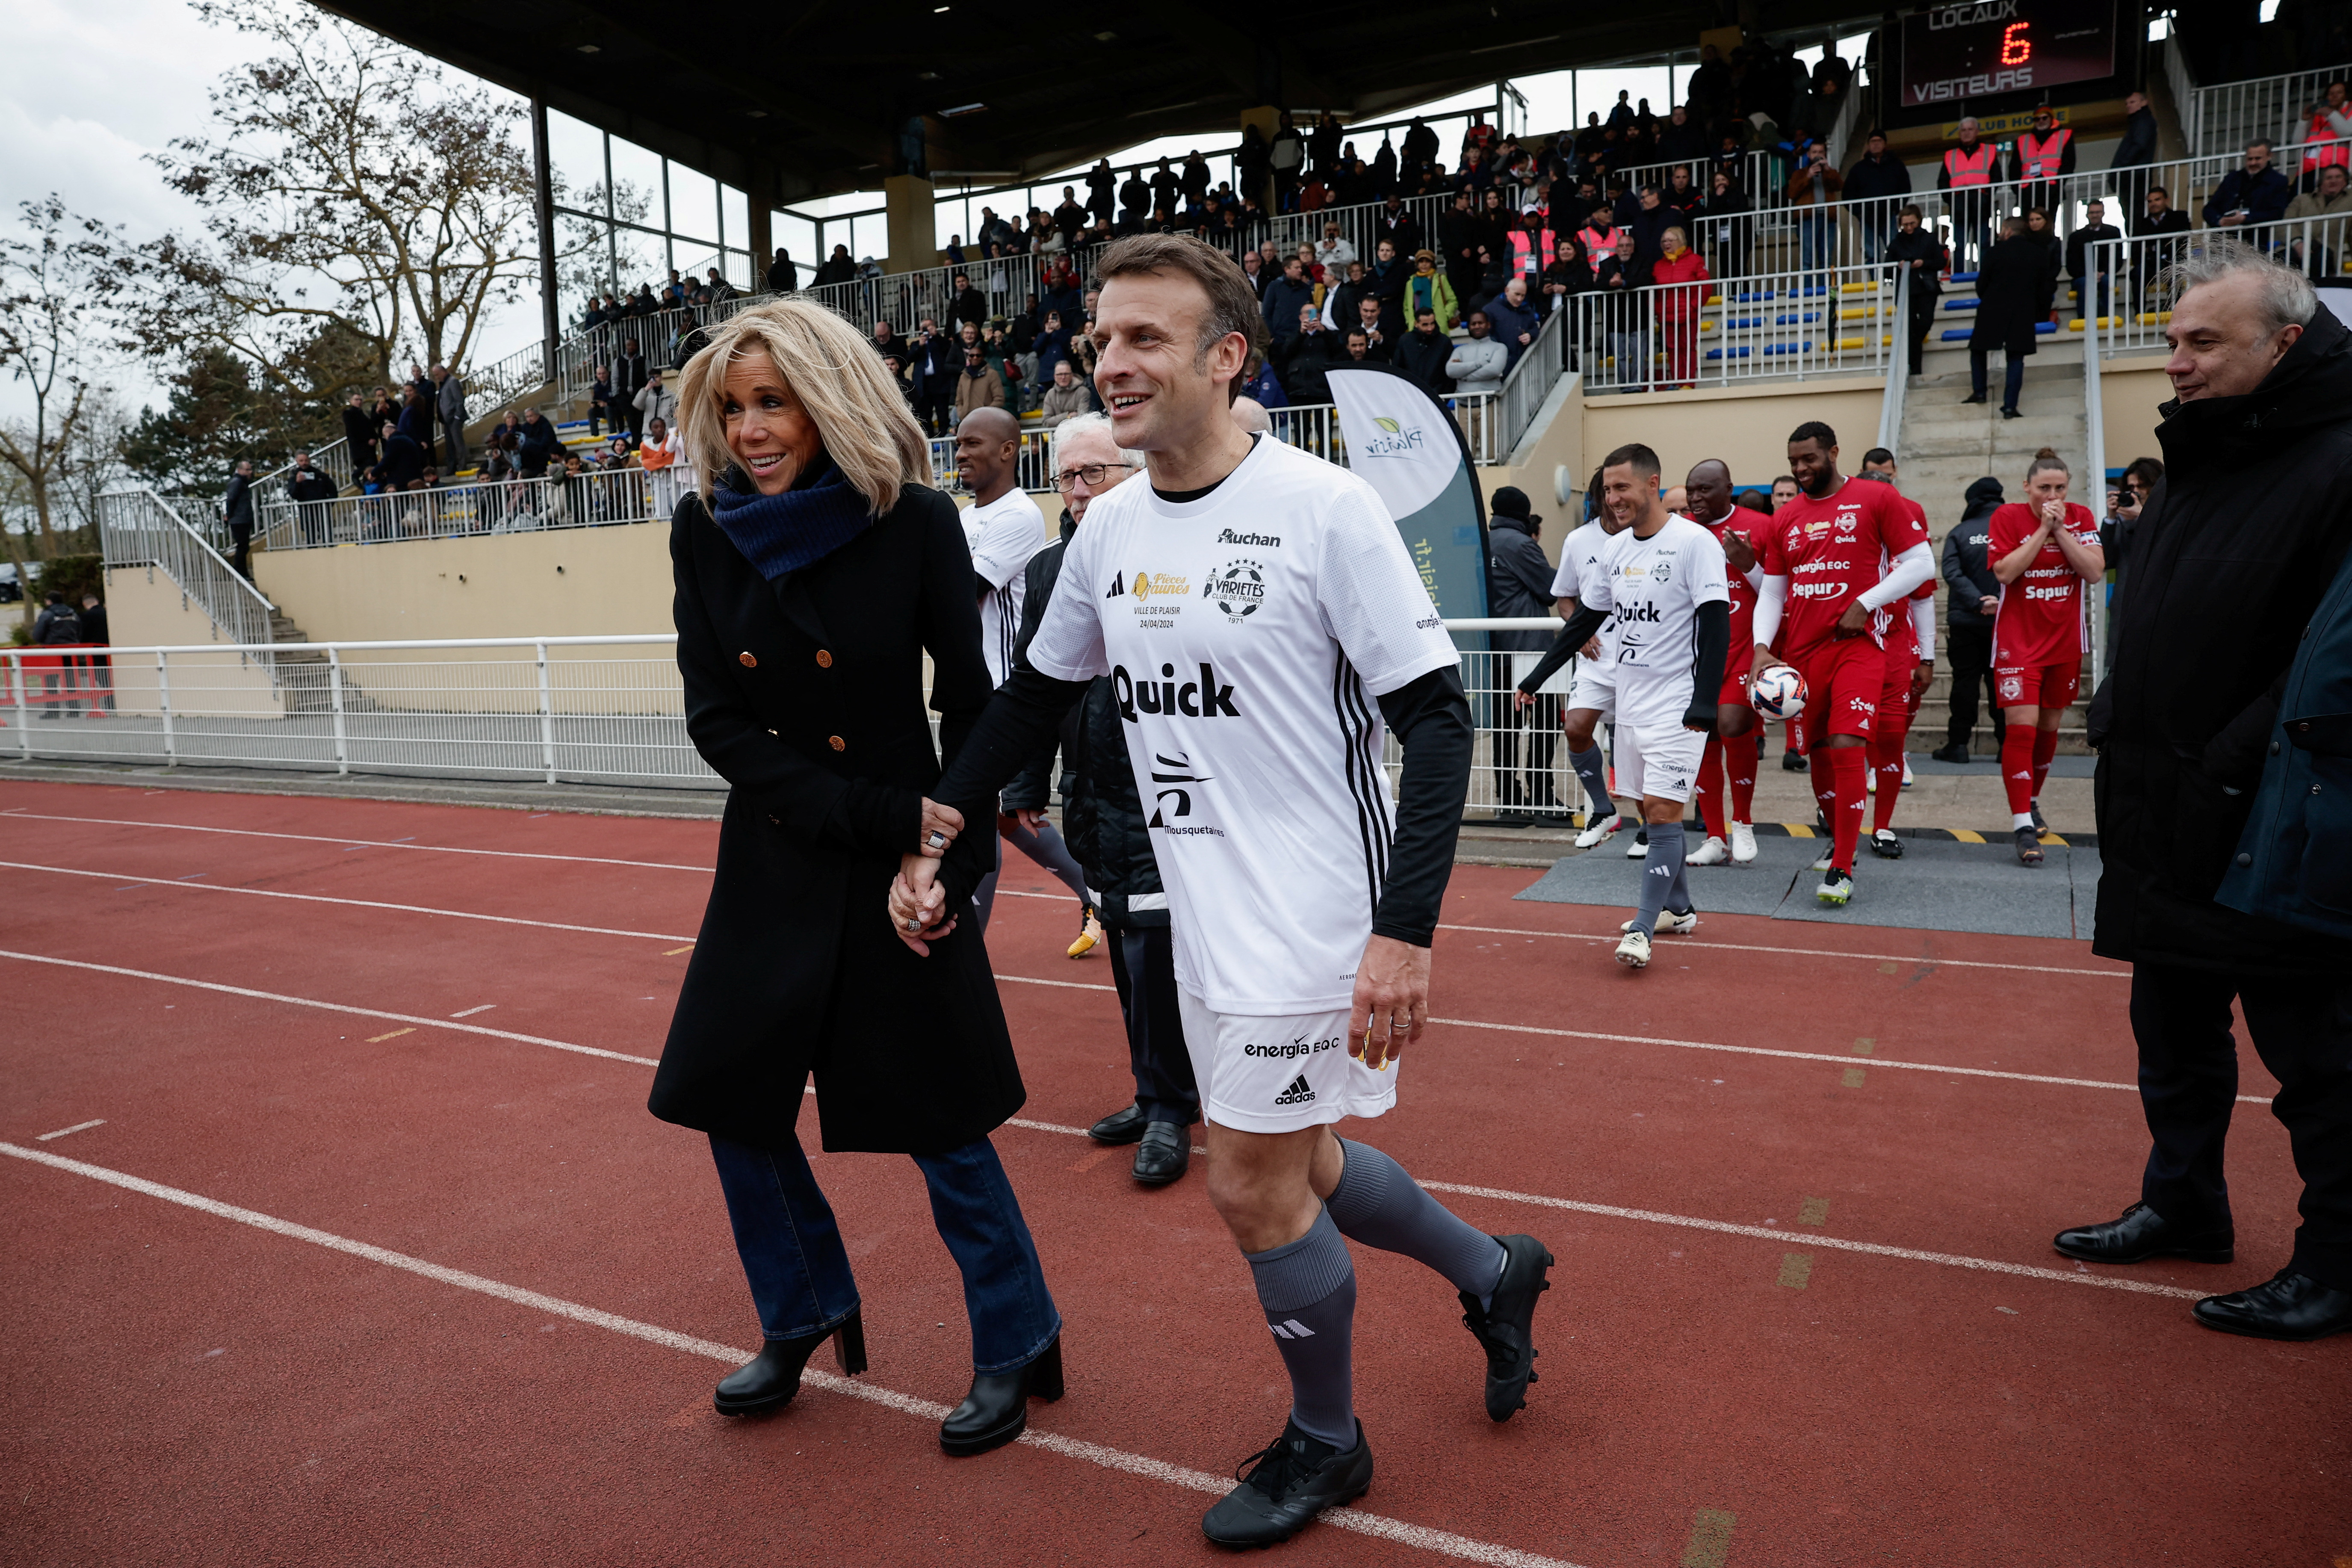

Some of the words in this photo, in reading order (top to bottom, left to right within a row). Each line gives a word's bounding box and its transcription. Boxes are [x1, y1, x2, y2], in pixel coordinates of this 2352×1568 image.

[1929, 0, 2018, 31] LOCAUX
[2001, 21, 2031, 65] 6
[1913, 67, 2033, 102] VISITEURS
[1977, 119, 2006, 131] LUB
[2012, 111, 2065, 127] HOE
[1217, 528, 1281, 548] Auchan
[1835, 534, 1857, 544] Quick
[1827, 560, 1851, 570] EQC
[1153, 572, 1186, 585] Pièces
[1728, 580, 1741, 588] QC
[1214, 579, 1265, 597] VARIETES
[1792, 582, 1835, 599] Sepur
[2025, 585, 2069, 601] Sepur
[1238, 596, 1264, 605] FRANCE
[1134, 606, 1149, 615] VILLE
[1150, 606, 1158, 614] DE
[1159, 606, 1180, 615] PLAISIR
[1615, 601, 1661, 625] Quick
[1140, 619, 1173, 629] 24/04/2024
[1113, 663, 1241, 723] Quick
[1164, 825, 1225, 838] Mousquetaires
[1313, 1037, 1340, 1054] EQC
[1275, 1090, 1316, 1105] adidas
